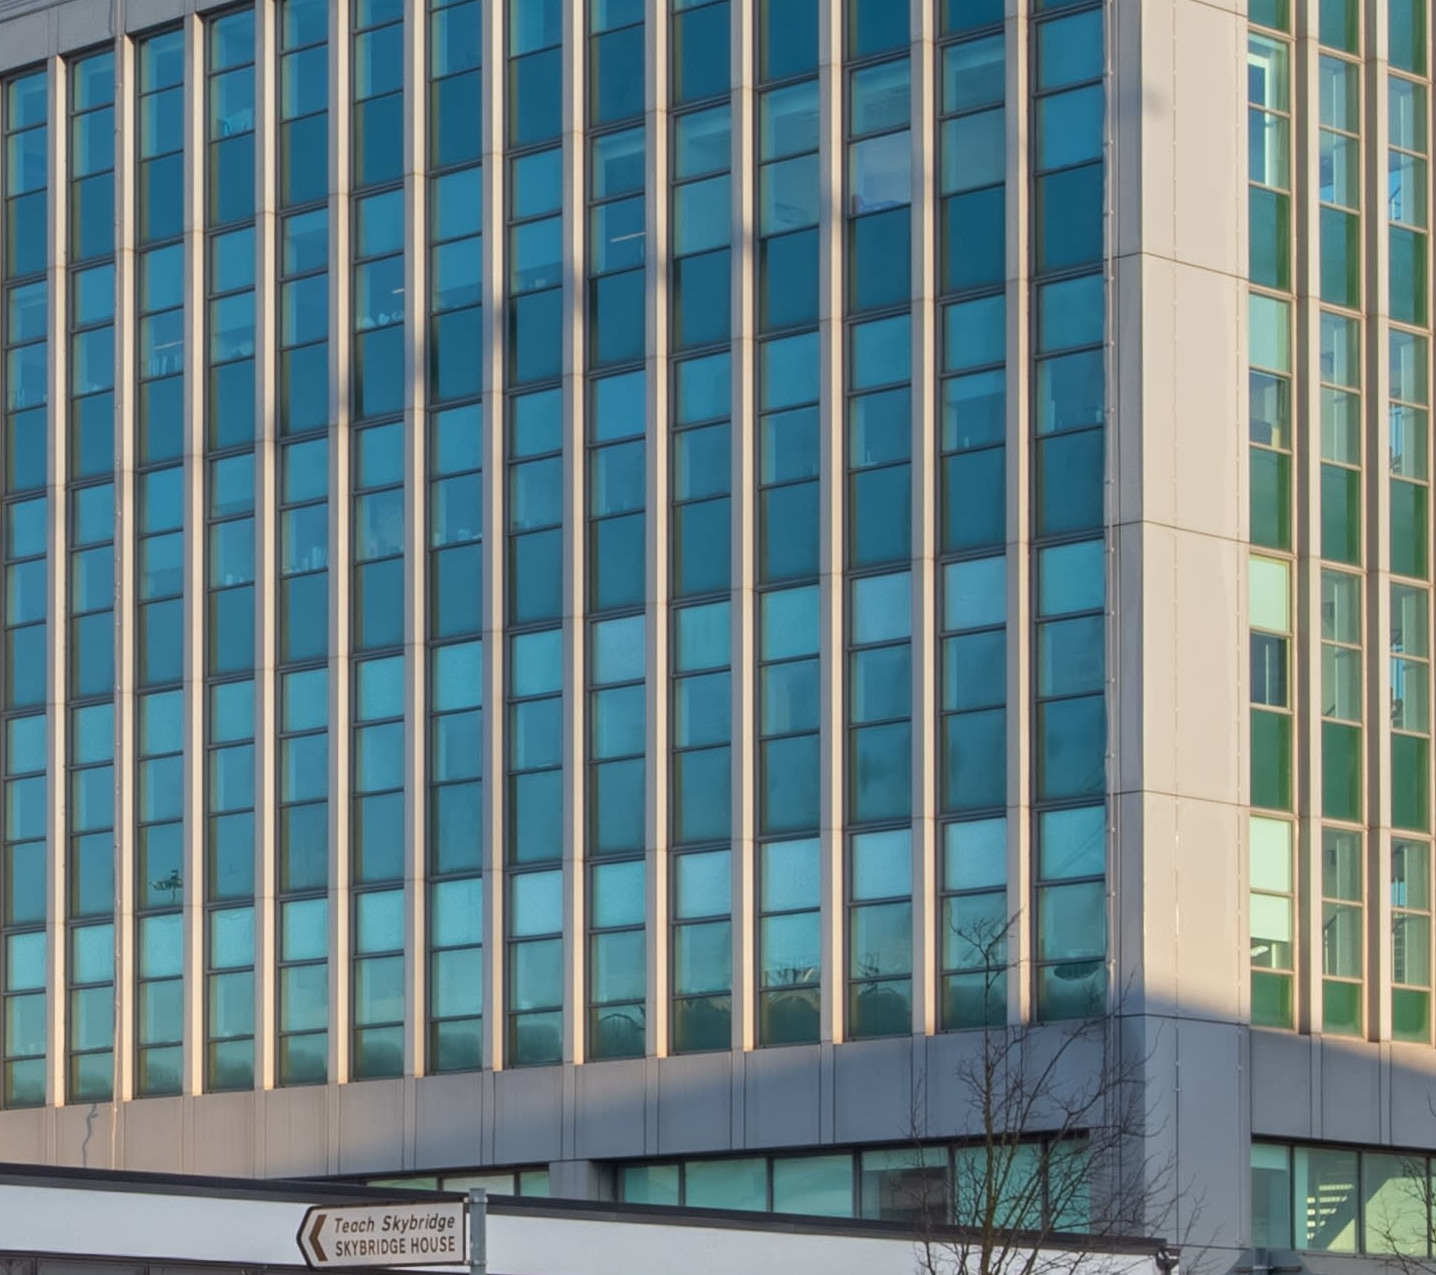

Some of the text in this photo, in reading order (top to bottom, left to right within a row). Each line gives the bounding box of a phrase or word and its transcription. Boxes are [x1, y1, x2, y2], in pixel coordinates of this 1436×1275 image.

[334, 1213, 455, 1236] Teach Skybridge
[335, 1235, 456, 1257] SKYBRIDGE HOUSE
